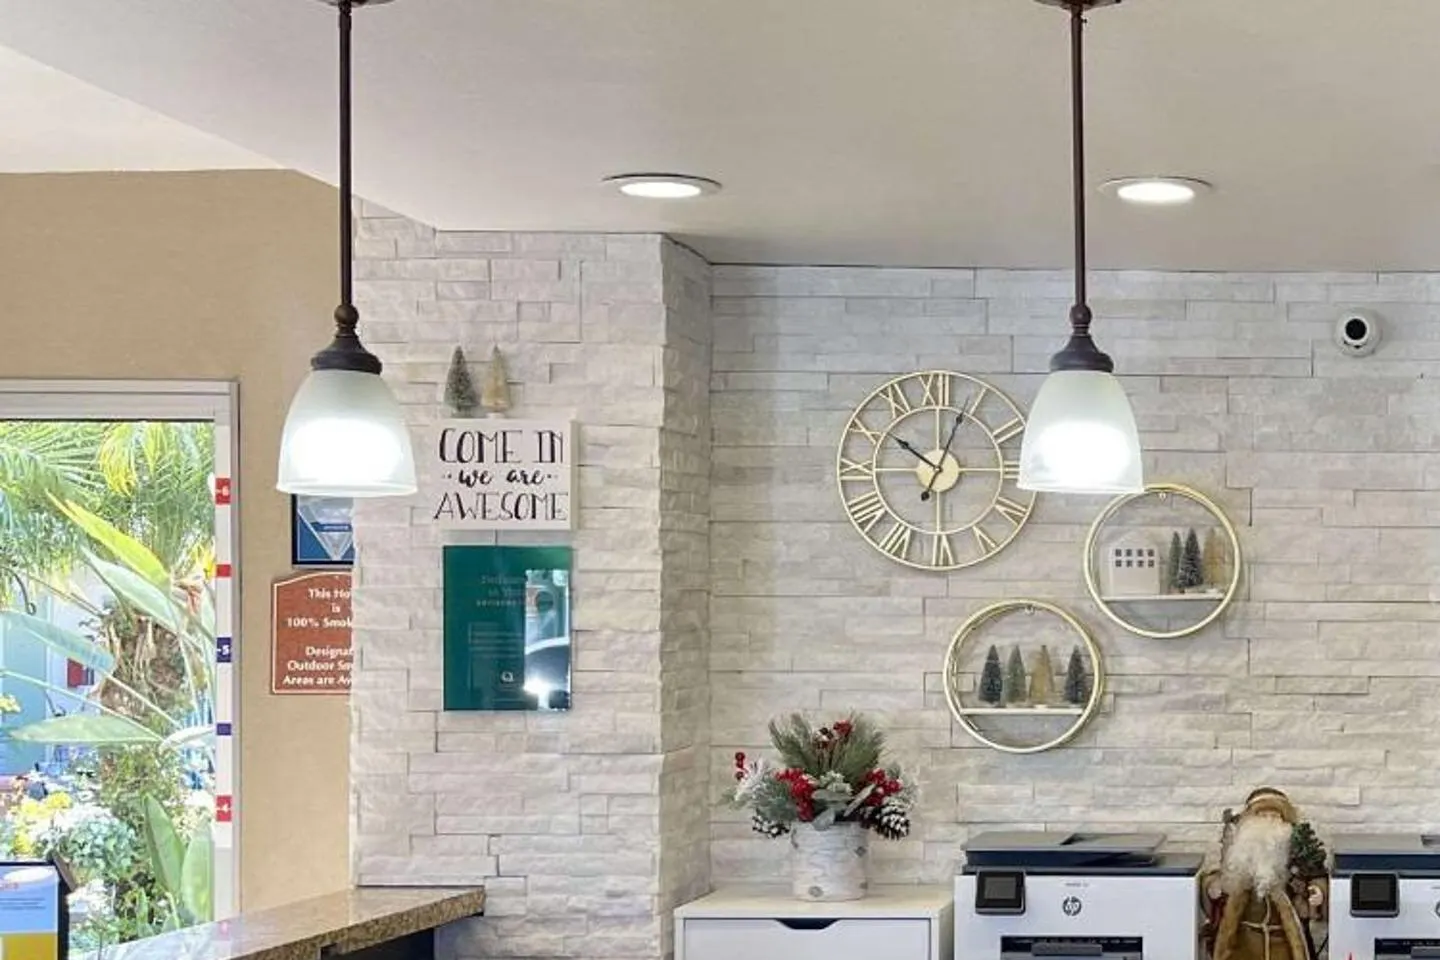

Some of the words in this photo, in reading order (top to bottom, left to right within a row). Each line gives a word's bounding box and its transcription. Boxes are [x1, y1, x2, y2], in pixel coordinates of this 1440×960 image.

[439, 427, 523, 464] COME
[532, 429, 564, 464] IN
[458, 468, 493, 488] we
[506, 469, 545, 485] are
[432, 491, 569, 521] AWESOME
[308, 588, 331, 599] This
[333, 589, 351, 599] Ho
[331, 602, 341, 613] is
[287, 617, 320, 628] 100%
[287, 660, 334, 671] Outdoor
[282, 675, 313, 685] Areas
[316, 677, 335, 685] are
